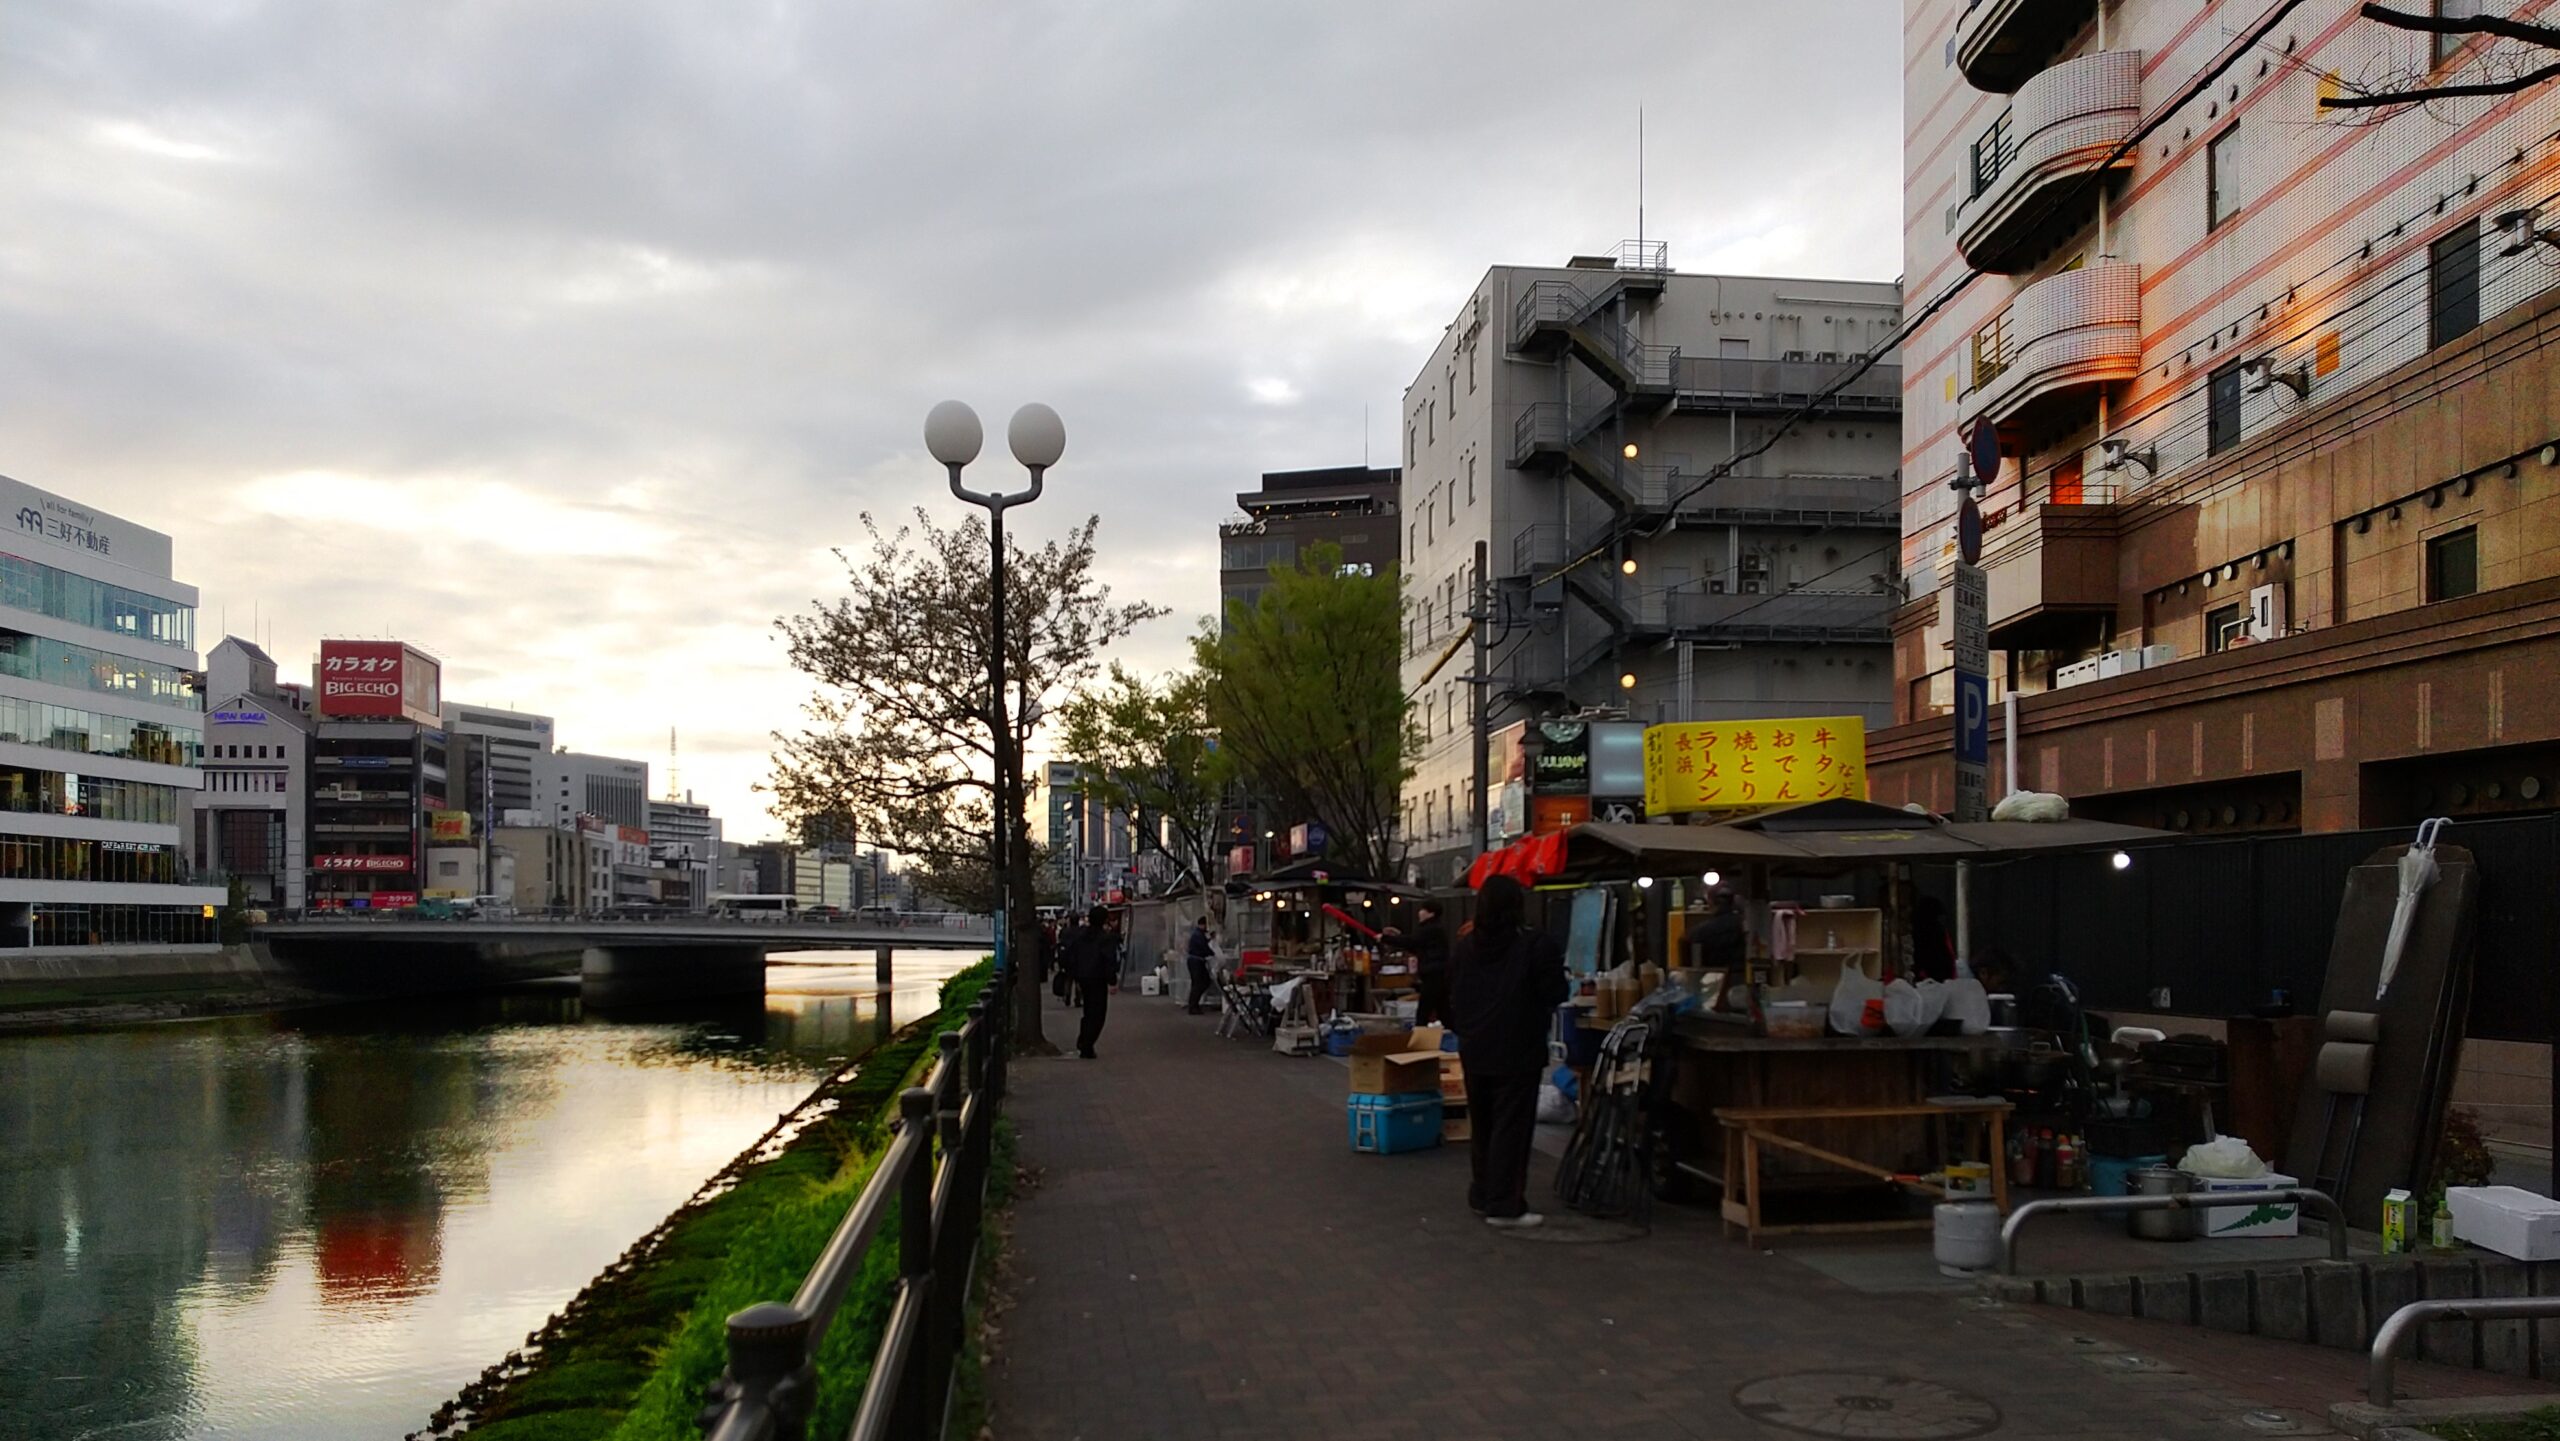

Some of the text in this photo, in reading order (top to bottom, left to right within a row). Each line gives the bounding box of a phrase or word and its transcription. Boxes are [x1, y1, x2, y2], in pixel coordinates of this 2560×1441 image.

[46, 517, 111, 556] 三好不動産
[325, 656, 397, 672] カラオケ
[325, 681, 399, 696] BIG ECHO
[1964, 681, 1983, 752] P
[1675, 732, 1694, 774] 長浜
[1696, 731, 1721, 801] ラーメン
[1733, 729, 1758, 800] 焼とり
[1773, 729, 1799, 800] おでん
[1812, 727, 1837, 798] 牛タン
[1838, 762, 1856, 798] など
[323, 858, 363, 868] カラオケ
[366, 859, 404, 868] BIG ECHO
